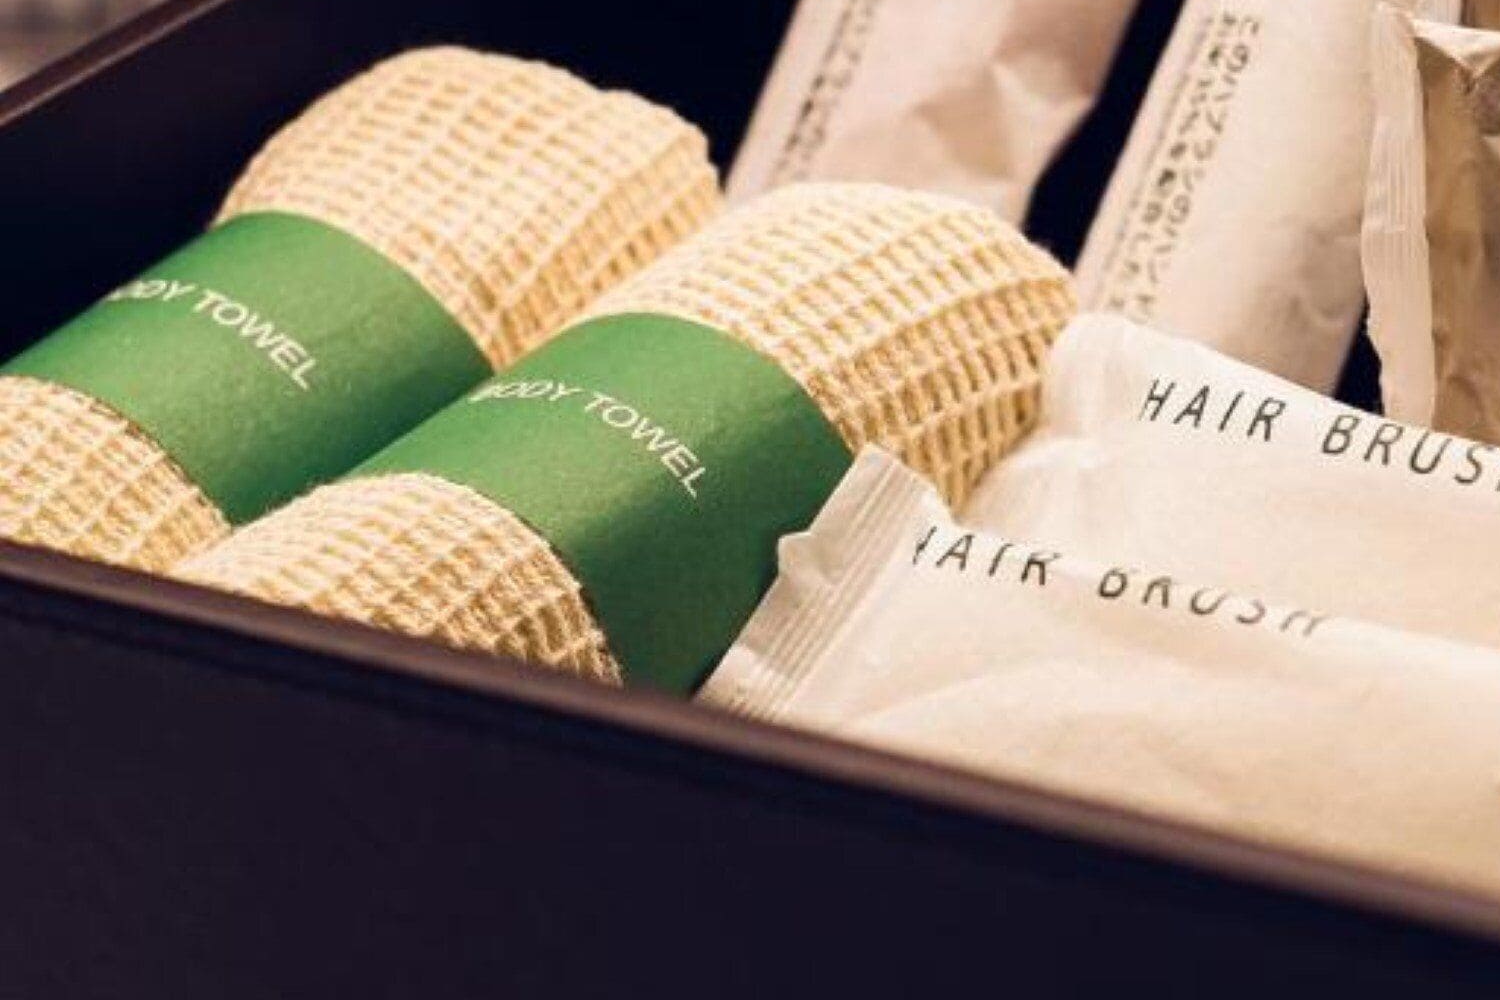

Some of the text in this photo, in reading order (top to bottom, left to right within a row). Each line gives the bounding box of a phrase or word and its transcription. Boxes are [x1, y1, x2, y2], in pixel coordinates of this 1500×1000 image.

[192, 288, 317, 391] TOWEL
[584, 392, 706, 500] TOWEL
[1140, 379, 1286, 442] HAIR
